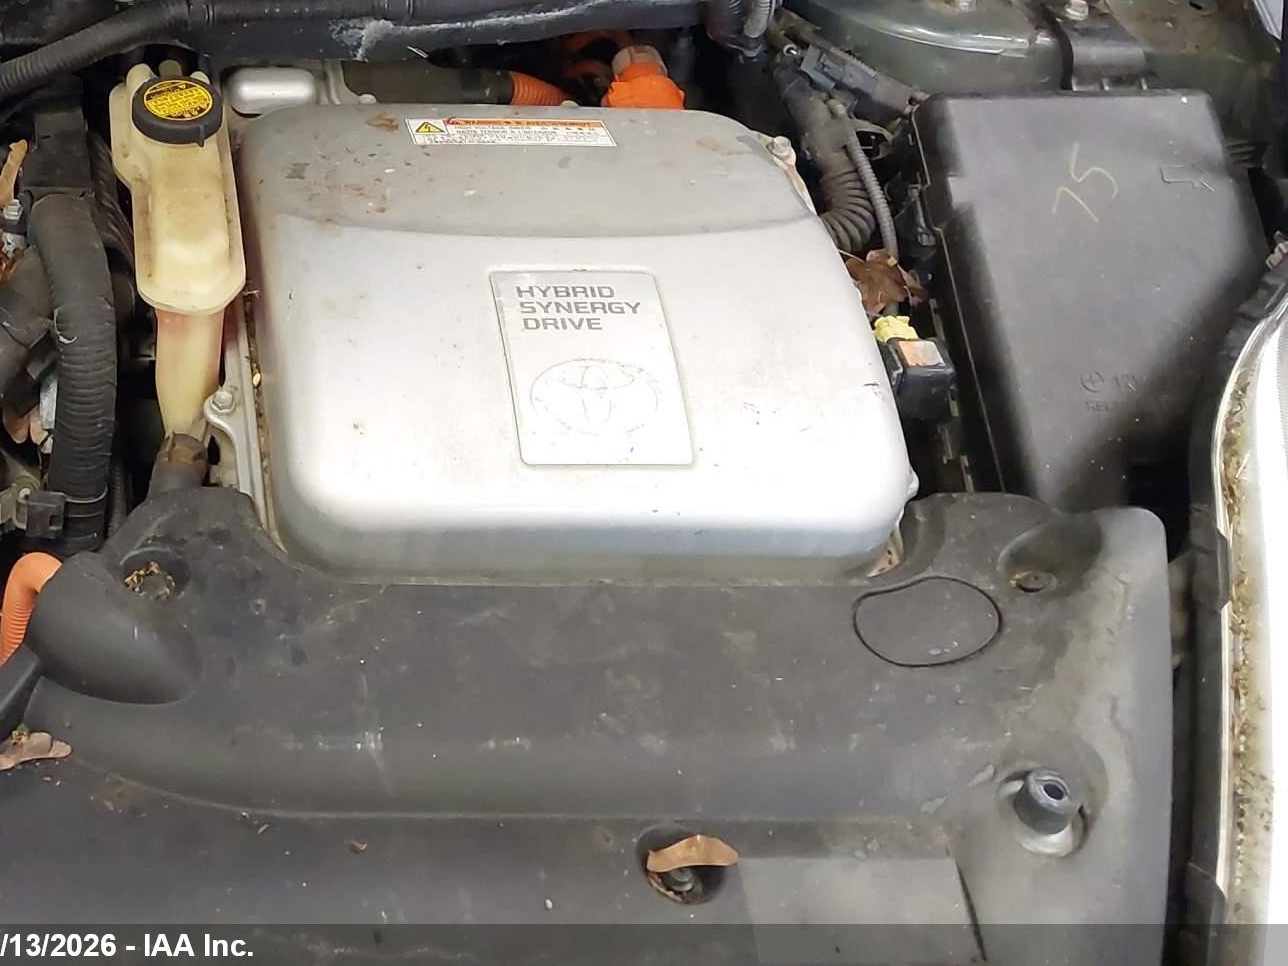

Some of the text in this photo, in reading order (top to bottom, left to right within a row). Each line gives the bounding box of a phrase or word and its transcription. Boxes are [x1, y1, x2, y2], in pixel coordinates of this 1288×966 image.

[516, 285, 615, 298] HYBRID
[519, 301, 641, 315] SYNERGY
[522, 317, 603, 330] DRIVE
